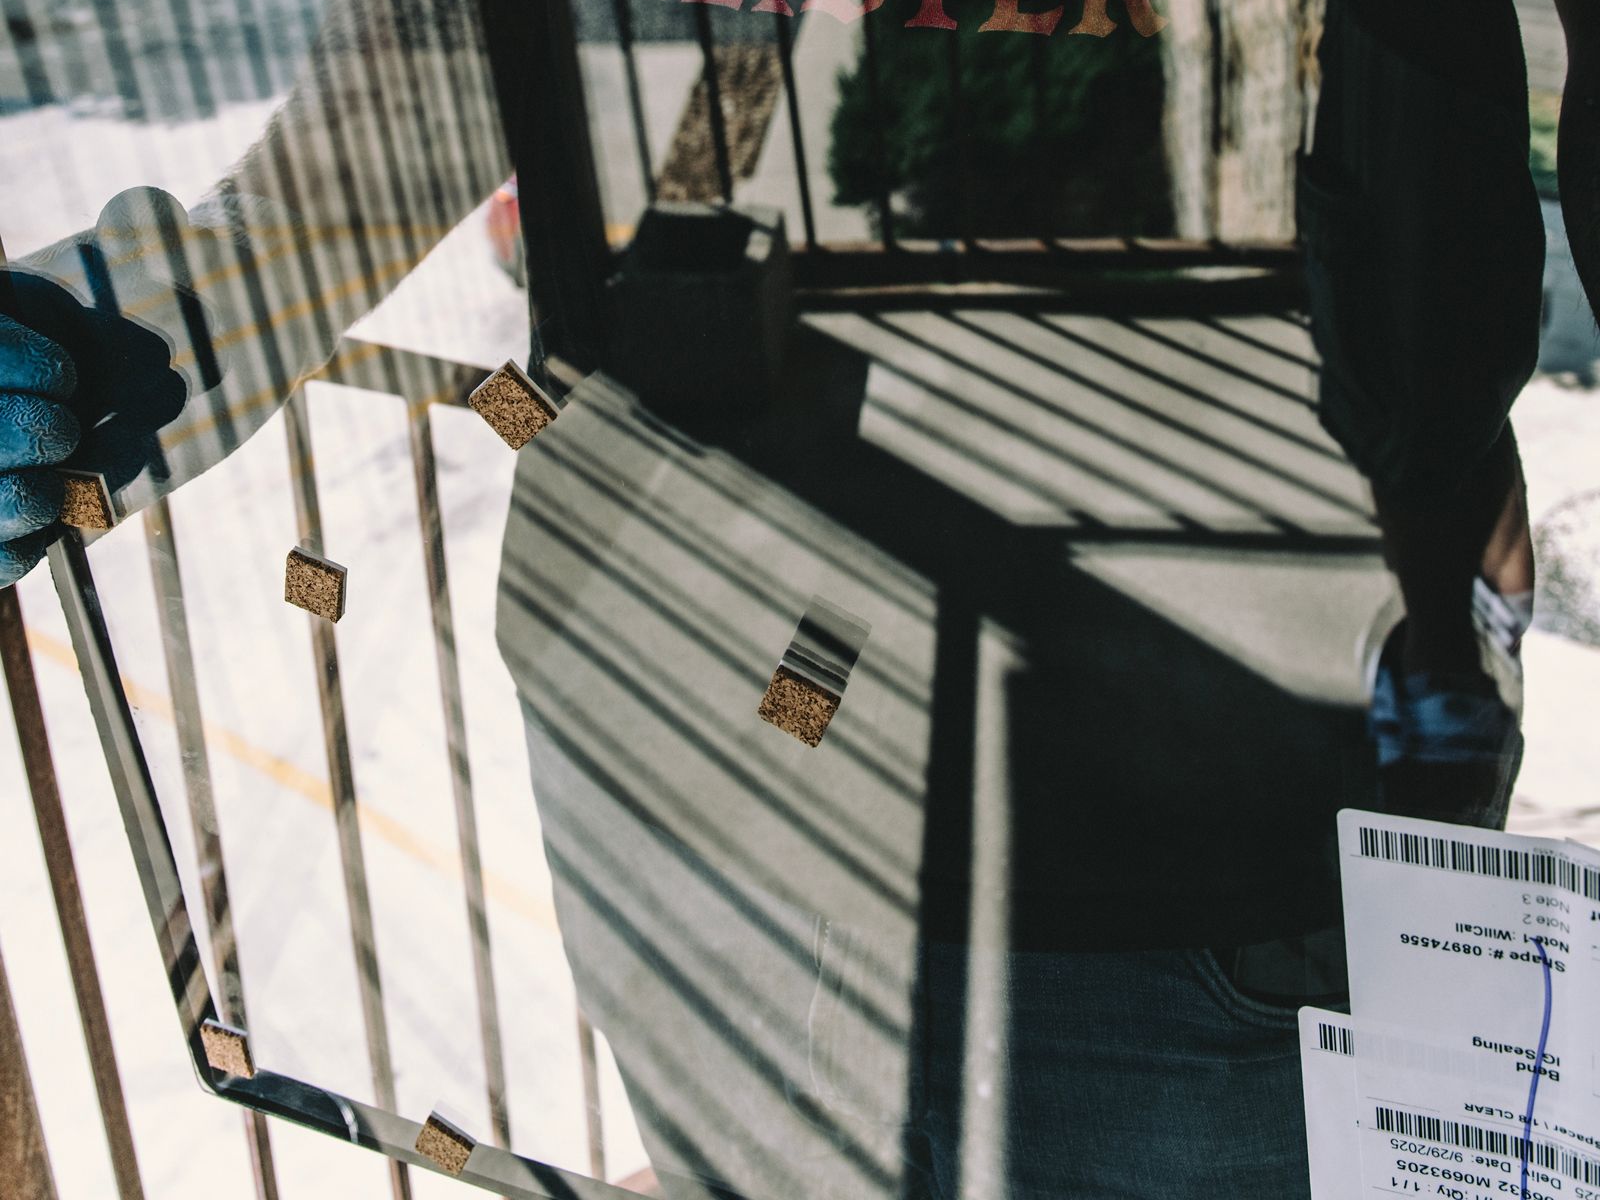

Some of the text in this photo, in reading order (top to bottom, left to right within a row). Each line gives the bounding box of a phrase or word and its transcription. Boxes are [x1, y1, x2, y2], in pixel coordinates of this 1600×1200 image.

[1522, 893, 1570, 914] Note 3
[1522, 913, 1570, 934] Note 2
[1399, 933, 1482, 957] 08974556
[1535, 935, 1569, 953] Note
[1510, 951, 1565, 973] Shape
[1471, 1036, 1536, 1061] Sealing
[1516, 1062, 1560, 1082] Bend
[1464, 1103, 1514, 1120] CLEAR
[1390, 1138, 1463, 1163] 9/29/2025
[1396, 1160, 1490, 1188] M0693205
[1471, 1155, 1511, 1173] Date:
